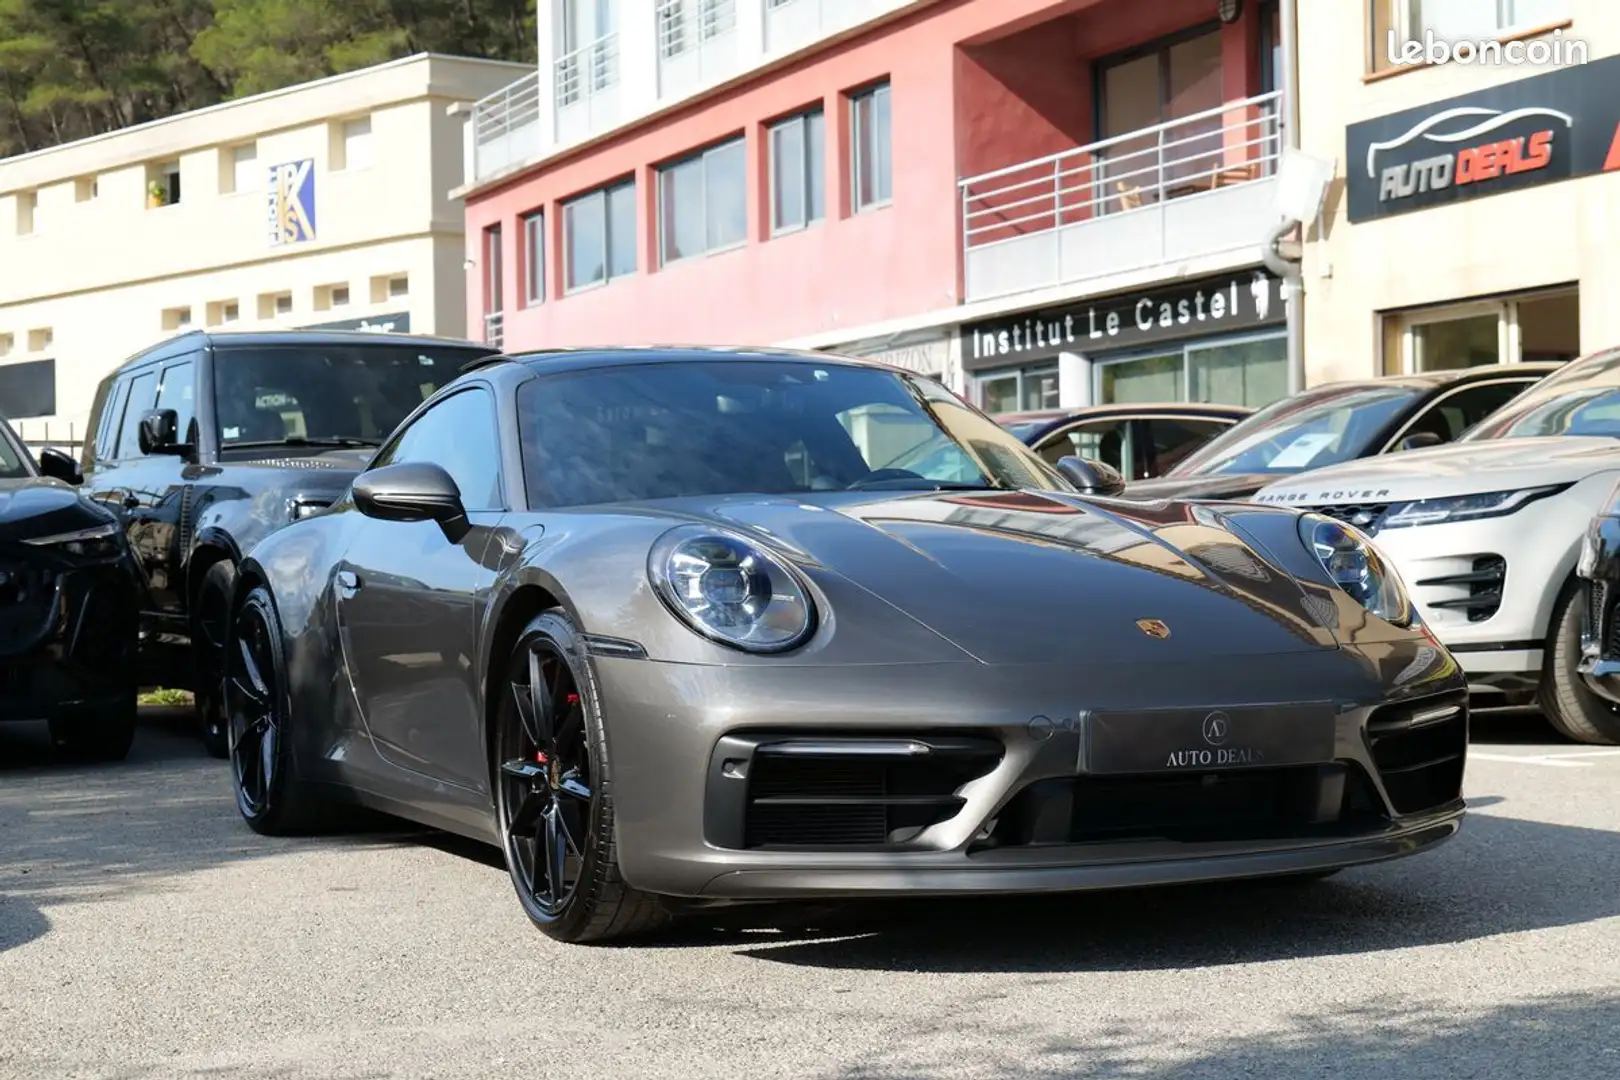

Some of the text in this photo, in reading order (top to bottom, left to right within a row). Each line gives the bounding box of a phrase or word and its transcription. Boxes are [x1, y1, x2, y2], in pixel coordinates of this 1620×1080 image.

[1379, 154, 1455, 201] AUTO
[1455, 130, 1554, 184] DEALS
[973, 279, 1238, 359] Institut Le Castel
[1319, 488, 1390, 500] ROVER
[1166, 749, 1212, 767] AUTO
